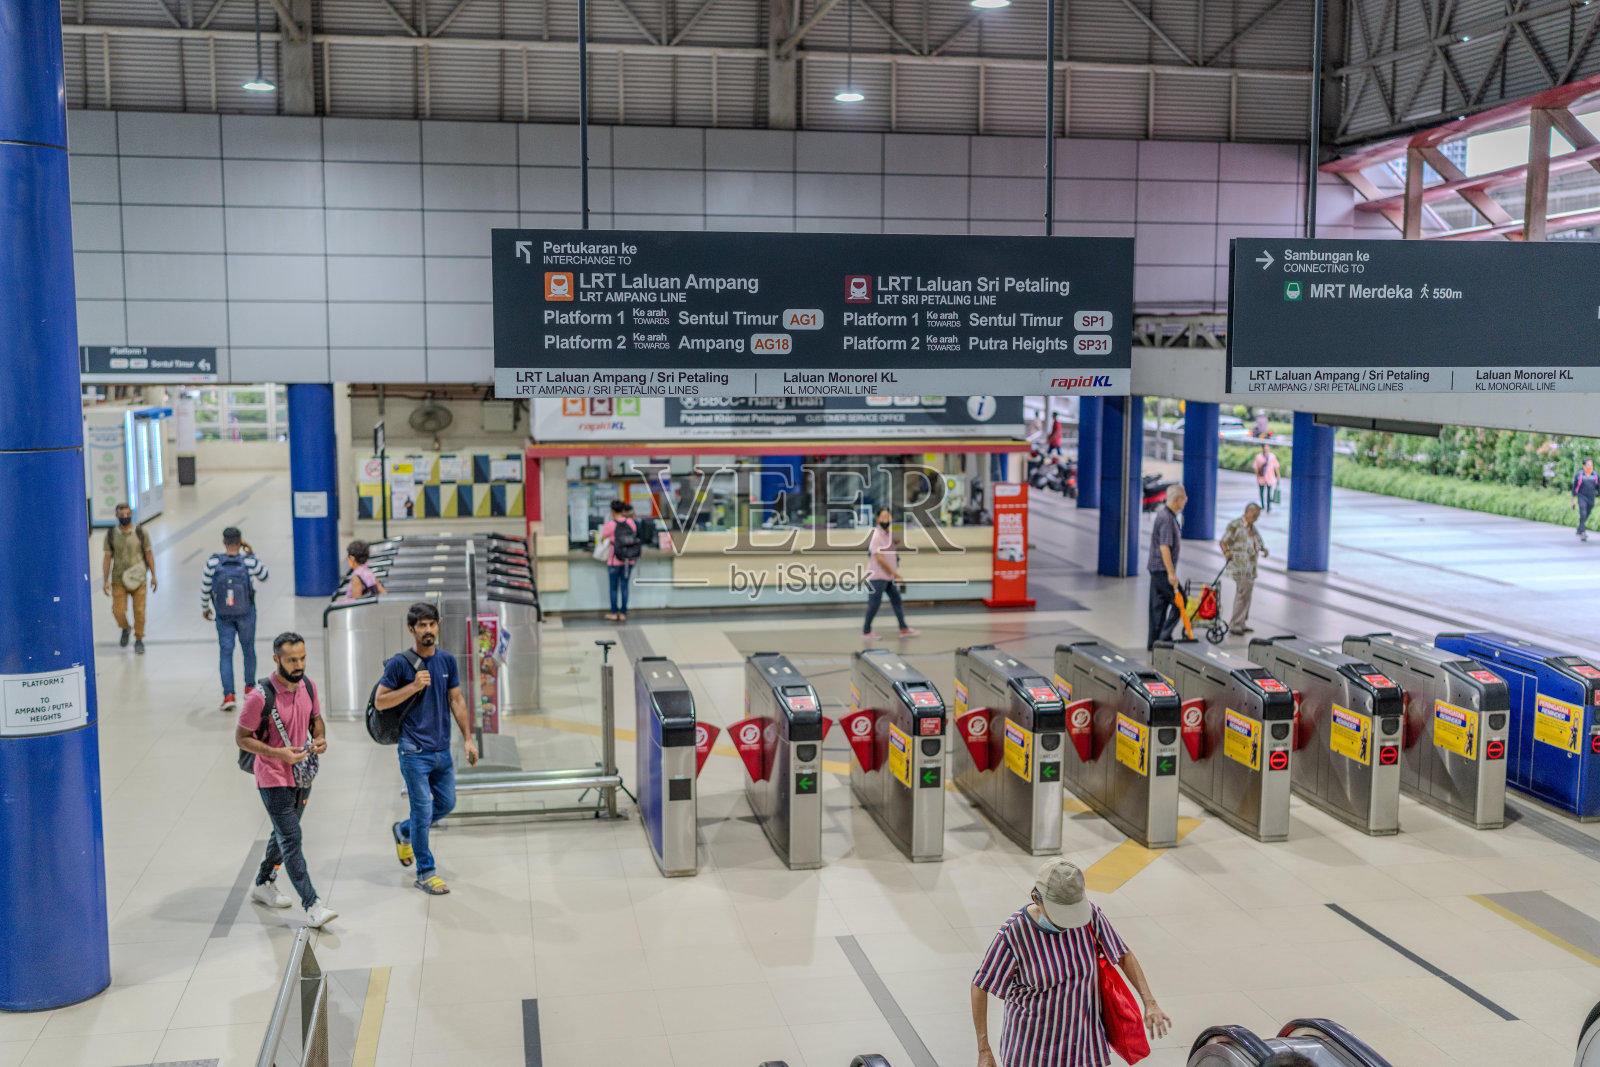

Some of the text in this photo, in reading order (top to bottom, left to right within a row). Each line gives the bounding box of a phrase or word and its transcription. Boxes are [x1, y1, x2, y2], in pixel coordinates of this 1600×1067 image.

[544, 242, 637, 254] Pertukaran ke
[544, 256, 632, 265] INTERCHANGE TO
[1284, 250, 1370, 263] Sambungan ke
[1284, 264, 1364, 273] CONNECTING TO
[580, 273, 759, 293] LRT Laluan Ampang
[878, 276, 1070, 296] LRT Laluan Sri Petaling
[580, 292, 686, 302] LRT AMPANG LINE
[1310, 284, 1462, 299] MRT Merdeka 550m
[878, 295, 996, 305] LRT SRI PETALING LINE
[544, 310, 624, 324] Platform 1
[633, 308, 666, 317] Ke arah
[678, 311, 779, 325] Sentul Timur
[926, 311, 958, 319] Ke arah
[790, 314, 816, 326] AG1
[844, 312, 919, 326] Platform 1
[969, 313, 1063, 326] Sentul Timur
[1082, 316, 1104, 327] SP1
[544, 335, 626, 349] Platform 2
[633, 333, 667, 341] Ke arah
[926, 335, 958, 343] Ke arah
[678, 336, 745, 353] Ampang
[755, 339, 789, 350] AG18
[844, 336, 920, 350] Platform 2
[969, 336, 1068, 353] Putra Heights
[1078, 340, 1107, 351] SP31
[516, 372, 542, 382] LRT
[546, 372, 590, 382] Laluan
[593, 372, 646, 385] Ampang
[658, 372, 674, 383] Sri
[679, 372, 729, 385] Petaling
[784, 372, 898, 383] Laluan Monorel KL
[1250, 370, 1272, 380] LRT
[1275, 370, 1311, 381] Laluan
[1314, 371, 1360, 382] Ampang
[1369, 370, 1384, 381] Sri
[1387, 371, 1430, 382] Petaling
[1476, 370, 1573, 380] Laluan Monorel KL
[1050, 376, 1112, 390] rapidKL
[1249, 383, 1266, 391] LRT
[1268, 383, 1307, 391] AMPANG
[1314, 383, 1329, 391] SRI
[1332, 383, 1375, 391] PETALING
[1378, 383, 1404, 391] LINES
[1476, 382, 1556, 390] KL MONORAIL LINE
[516, 386, 535, 394] LRT
[539, 386, 584, 394] AMPANG
[594, 386, 611, 394] SRI
[614, 386, 666, 394] PETALING
[669, 386, 699, 395] LINES
[784, 386, 877, 395] KL MONORAIL LINE
[22, 678, 59, 688] PLATFORM
[15, 707, 46, 715] AMPANG
[52, 702, 73, 711] PUTRA
[30, 713, 61, 722] HEIGHTS
